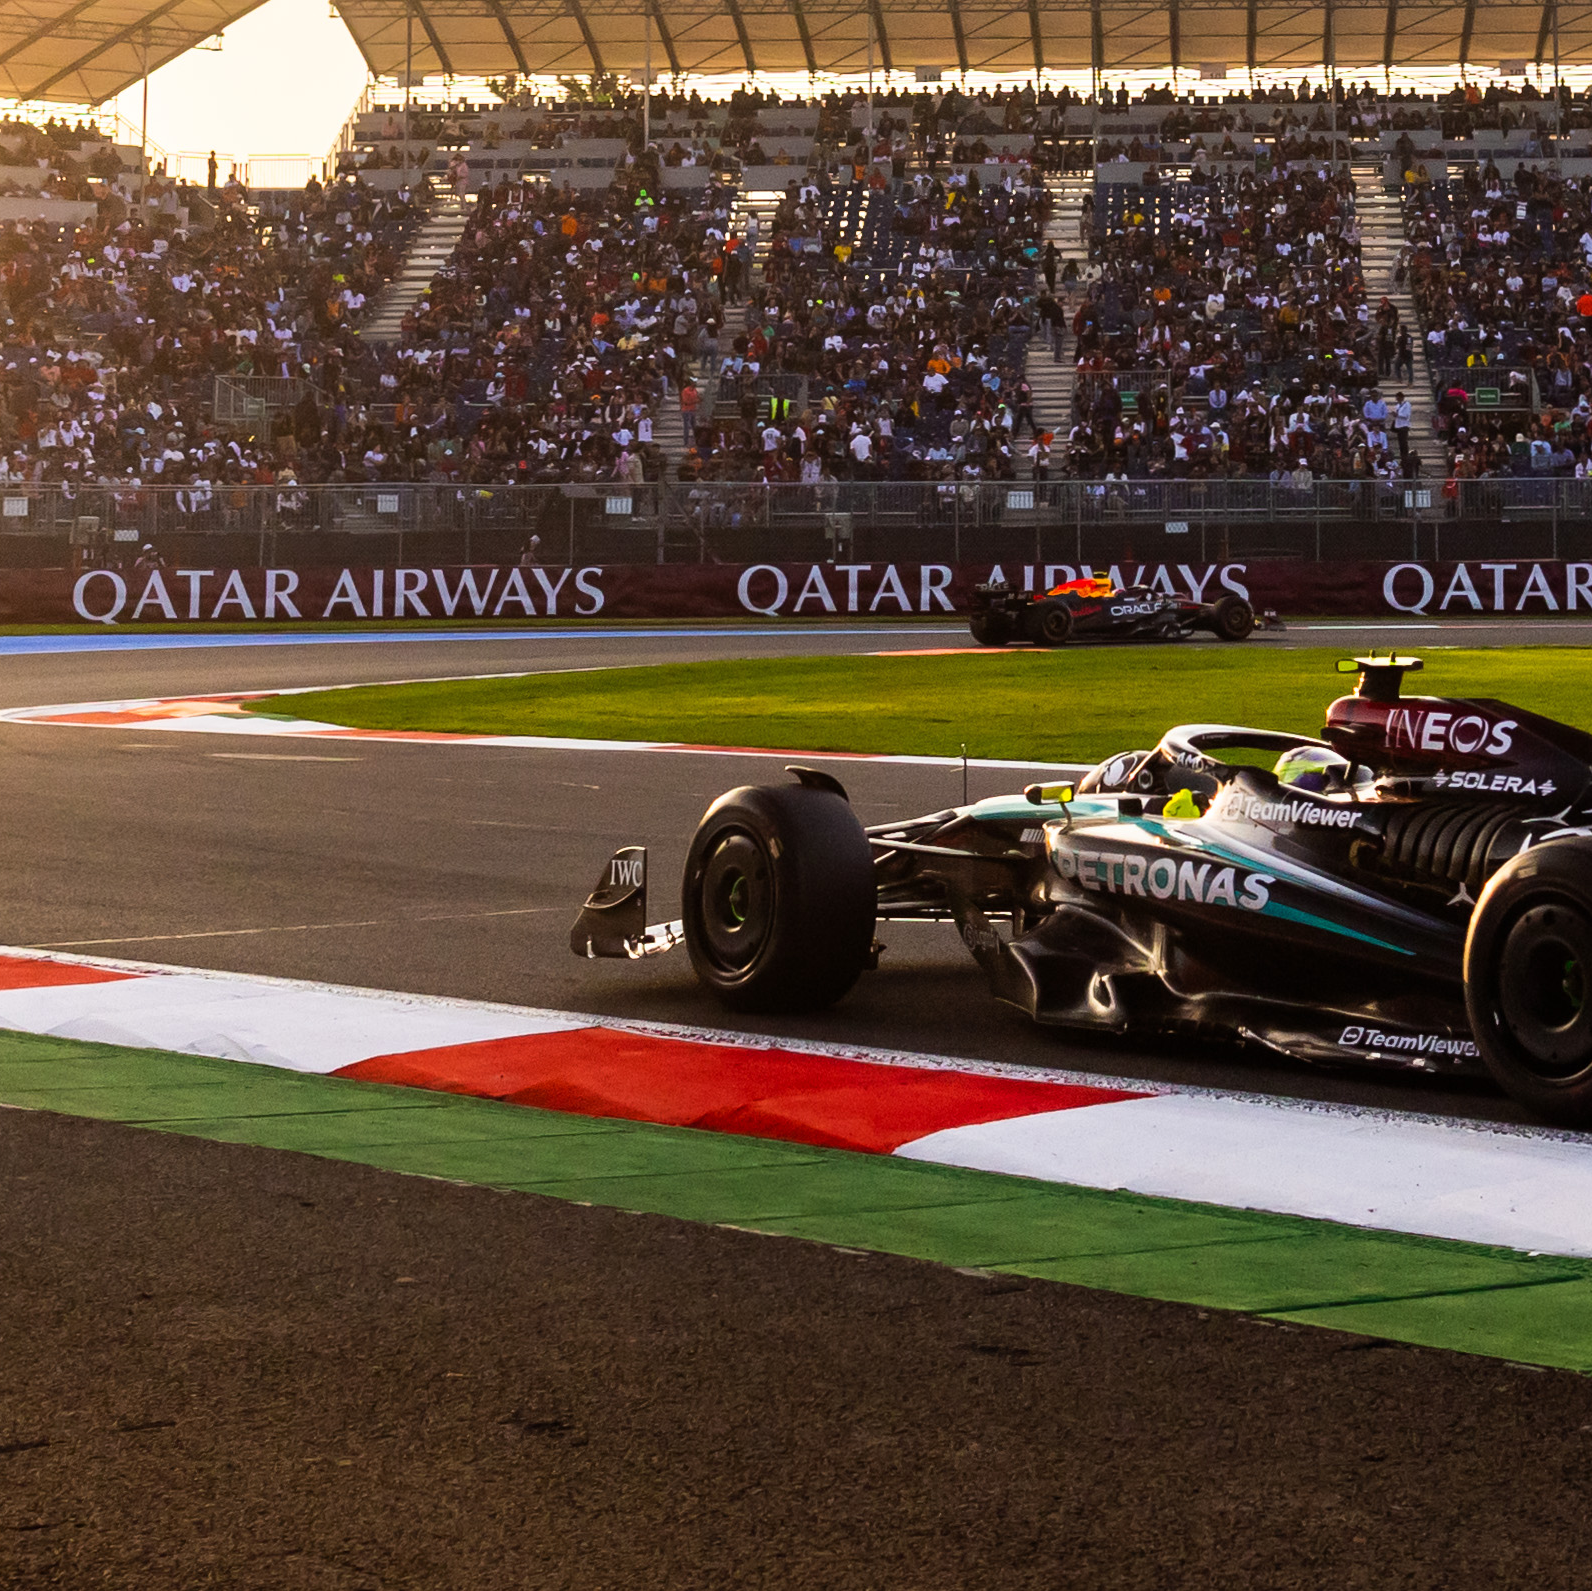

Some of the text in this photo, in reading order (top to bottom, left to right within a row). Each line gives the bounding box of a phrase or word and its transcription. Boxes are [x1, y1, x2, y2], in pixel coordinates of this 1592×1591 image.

[72, 567, 605, 625] QATAR AIRWAYS
[737, 564, 956, 617] QATAR
[1384, 707, 1519, 756] INEOS
[1448, 771, 1537, 795] SOLERA
[1244, 796, 1363, 829] TeamViewer
[609, 859, 643, 888] IWC
[1053, 846, 1277, 910] PETRONAS
